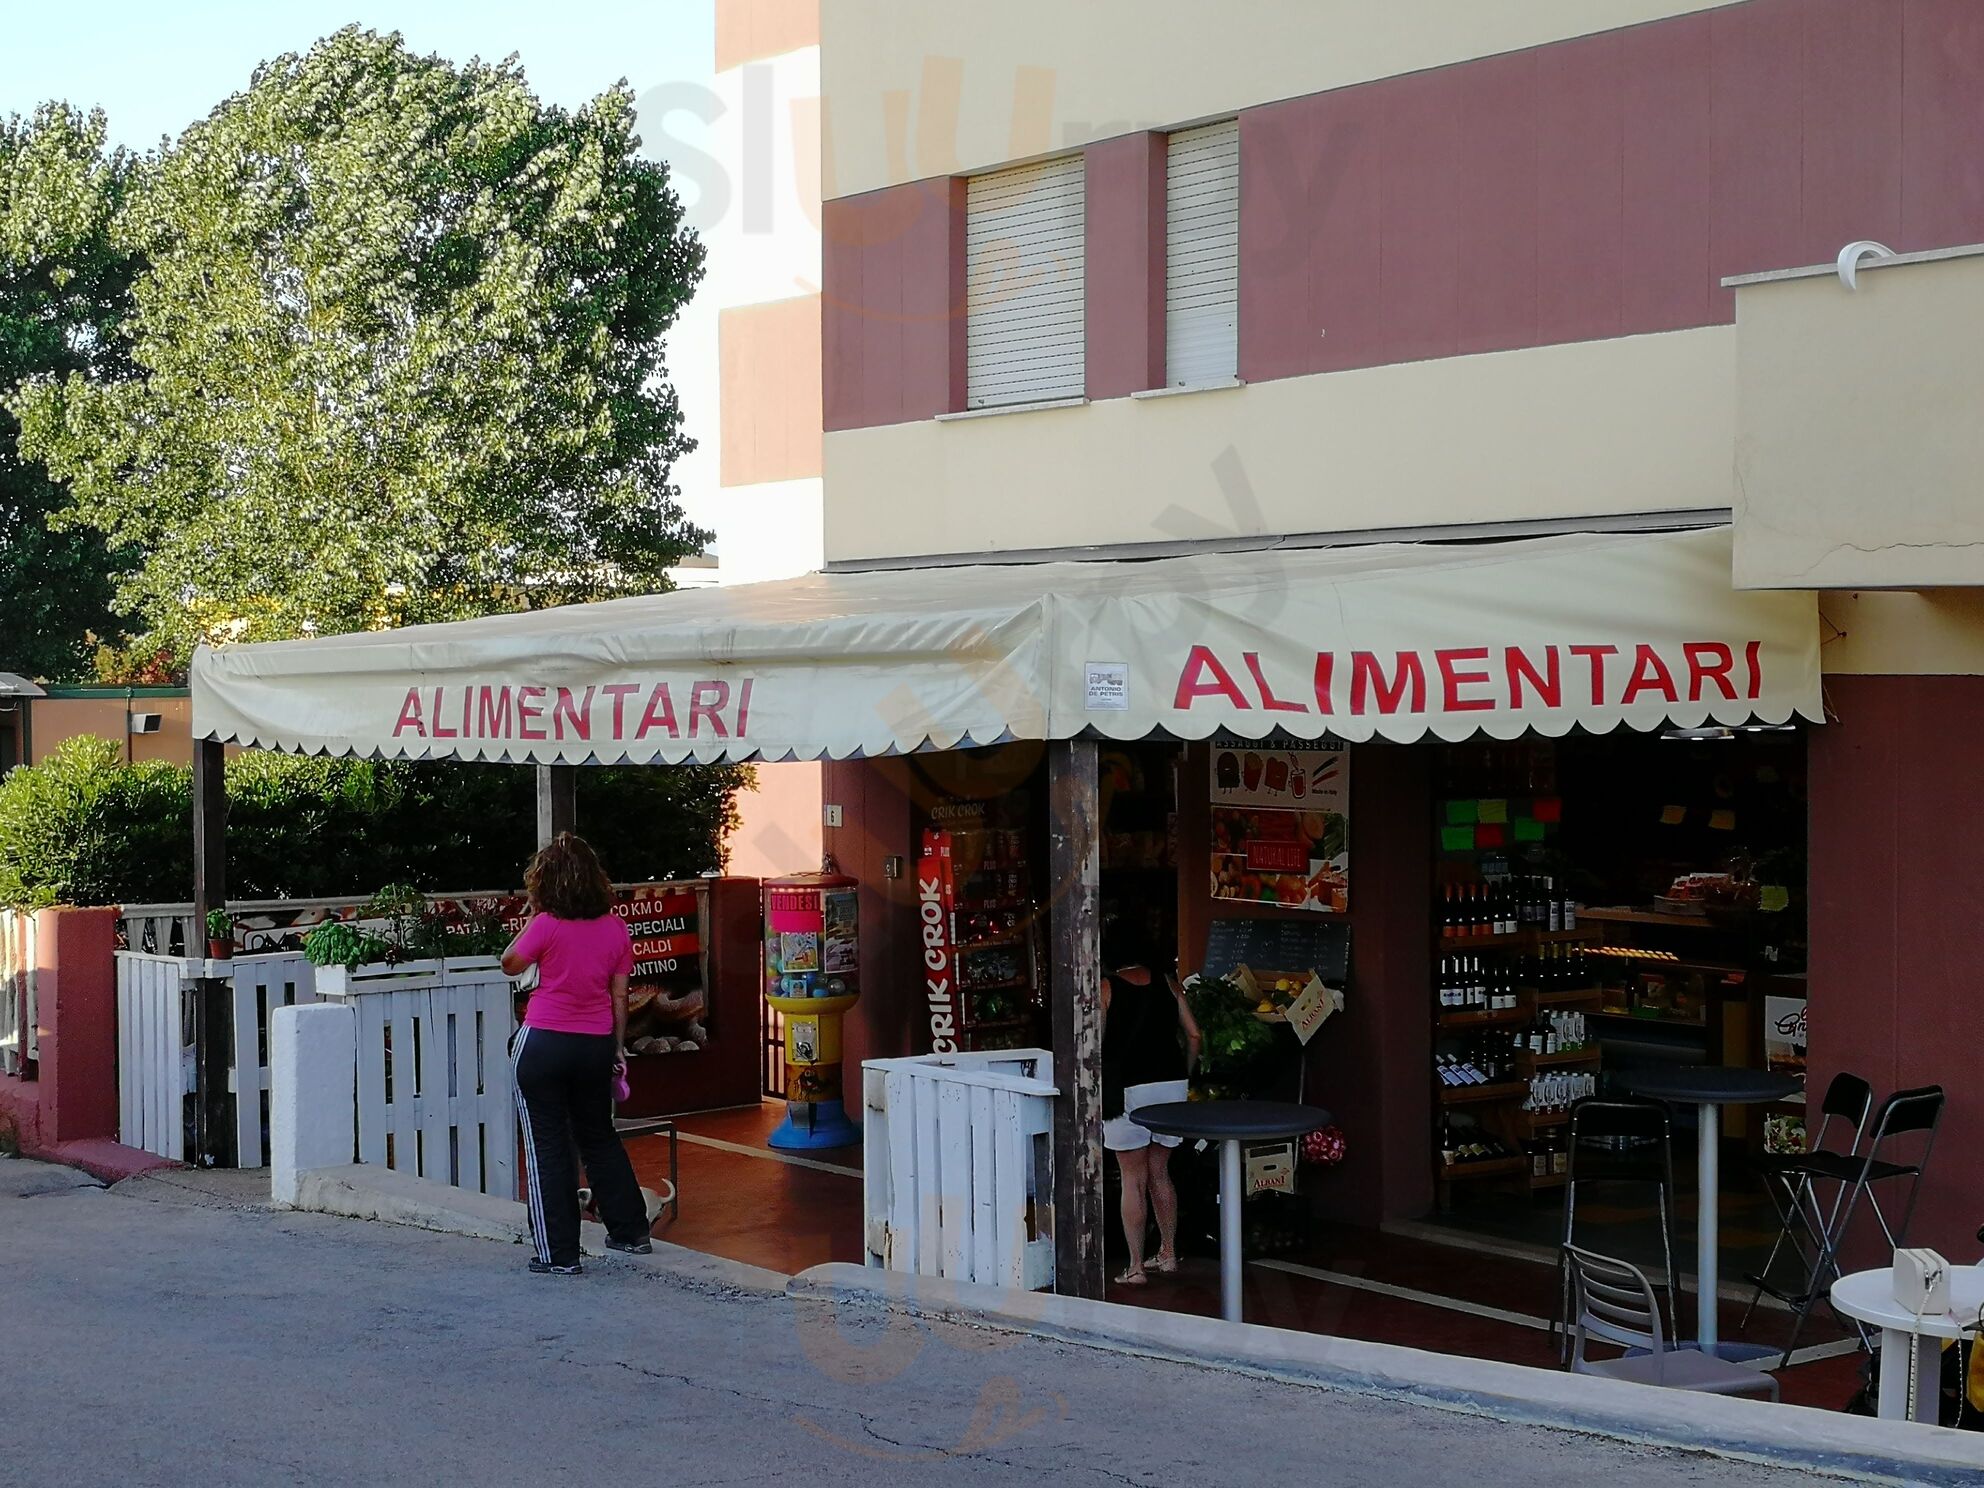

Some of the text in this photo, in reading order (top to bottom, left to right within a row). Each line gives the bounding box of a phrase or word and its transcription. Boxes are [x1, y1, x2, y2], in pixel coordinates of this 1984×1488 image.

[1173, 640, 1762, 716] ALIMENTARI
[391, 678, 754, 741] ALIMENTARI
[931, 803, 985, 820] CRIK CROK
[1252, 845, 1286, 867] NATURAL
[631, 901, 652, 916] KM
[771, 893, 819, 911] VENDESI
[627, 917, 686, 937] SPECIALI
[632, 939, 673, 956] CALDI
[919, 876, 960, 1055] CRIK CROK
[1253, 1175, 1285, 1189] ALBANI
